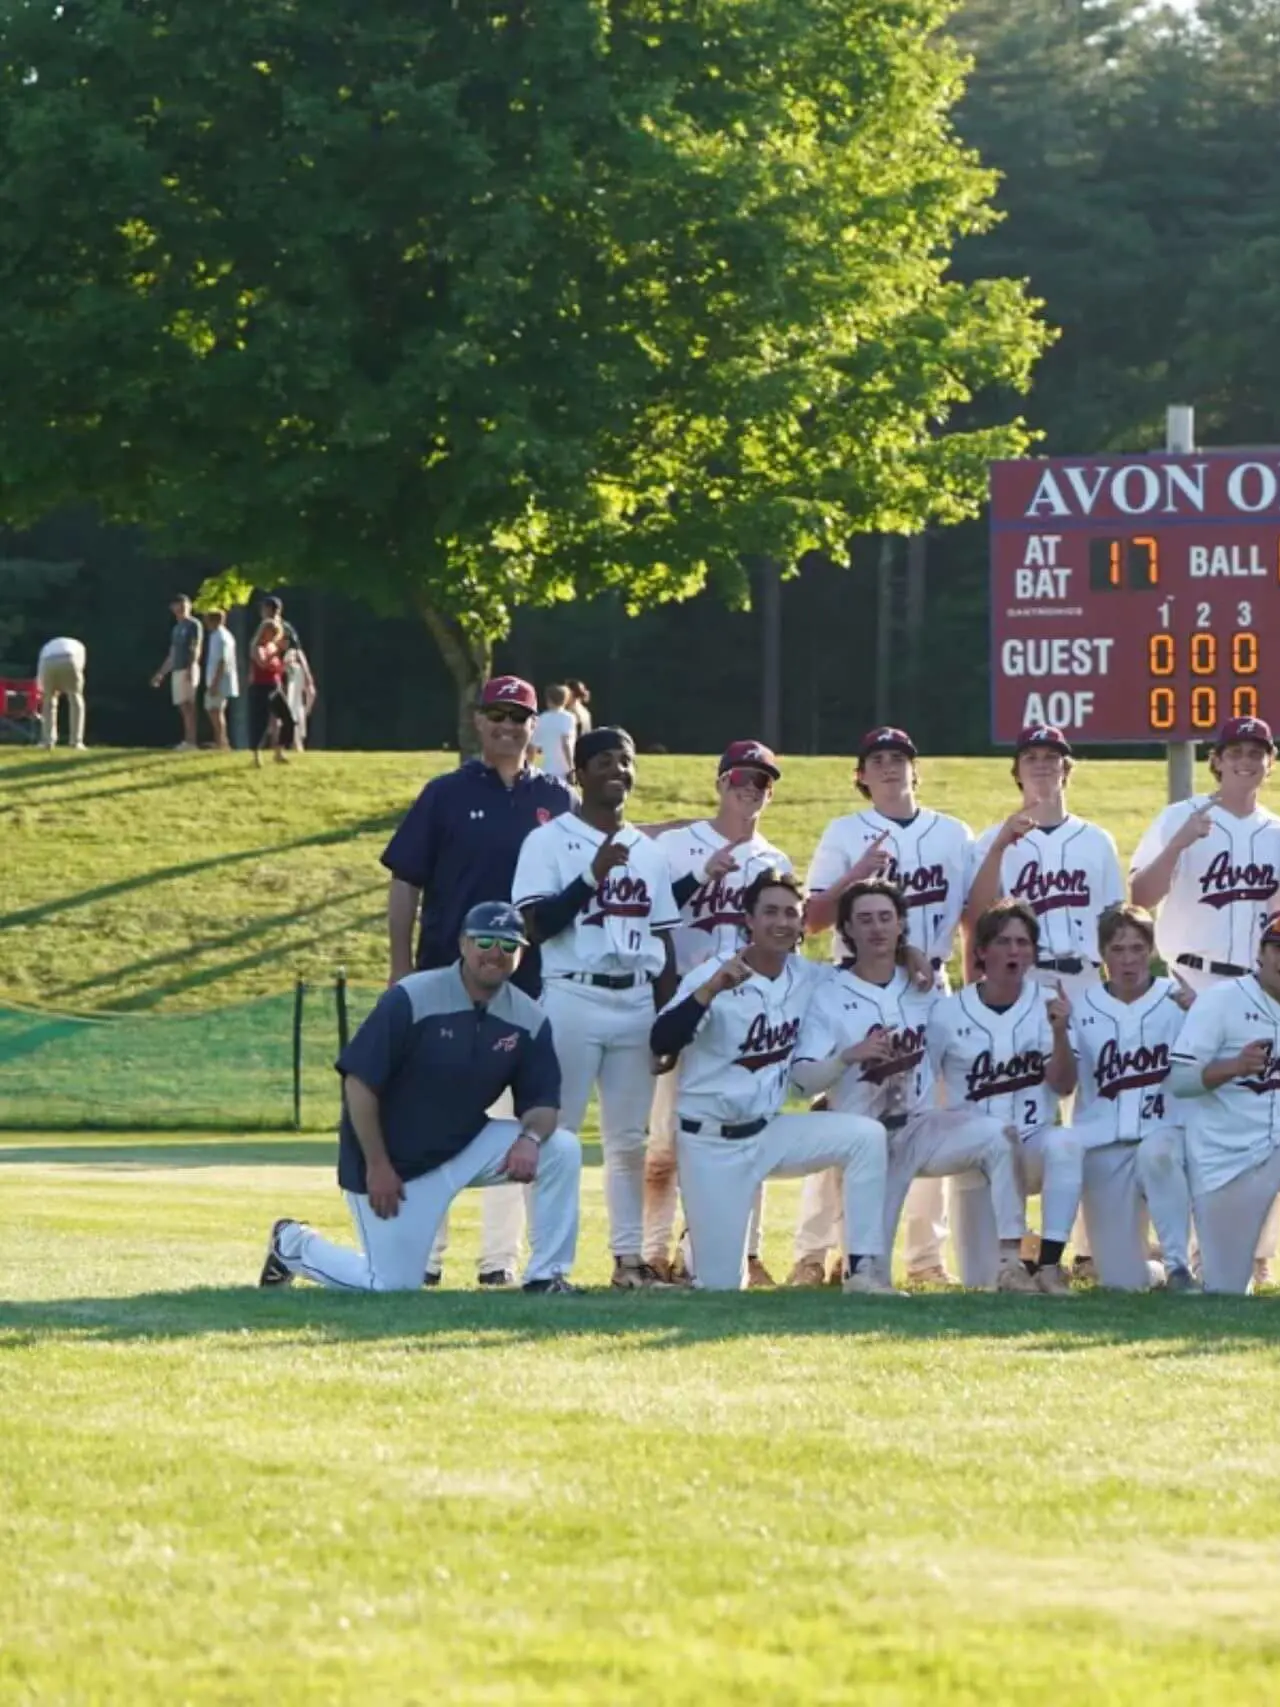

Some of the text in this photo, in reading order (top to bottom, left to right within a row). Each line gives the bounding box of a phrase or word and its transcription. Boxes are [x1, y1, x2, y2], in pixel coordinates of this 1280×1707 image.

[1025, 463, 1208, 517] AVON
[1024, 535, 1062, 566] AT
[1109, 536, 1158, 585] 17
[1189, 546, 1268, 577] BALL
[1016, 568, 1072, 599] BAT
[1157, 602, 1170, 628] 1
[1196, 602, 1212, 628] 2
[1237, 601, 1252, 627] 3
[1002, 638, 1114, 677] GUEST
[1150, 634, 1174, 675] 0
[1191, 633, 1216, 674] 0
[1233, 632, 1257, 673] 0
[1023, 691, 1094, 728] AOF
[1150, 687, 1174, 728] 0
[1191, 686, 1216, 727] 0
[1010, 860, 1090, 900] Avon
[1199, 850, 1279, 893] Avon
[966, 1049, 1044, 1092] Avon
[1093, 1038, 1170, 1088] Avon
[1023, 1099, 1038, 1125] 2
[1141, 1093, 1165, 1120] 24
